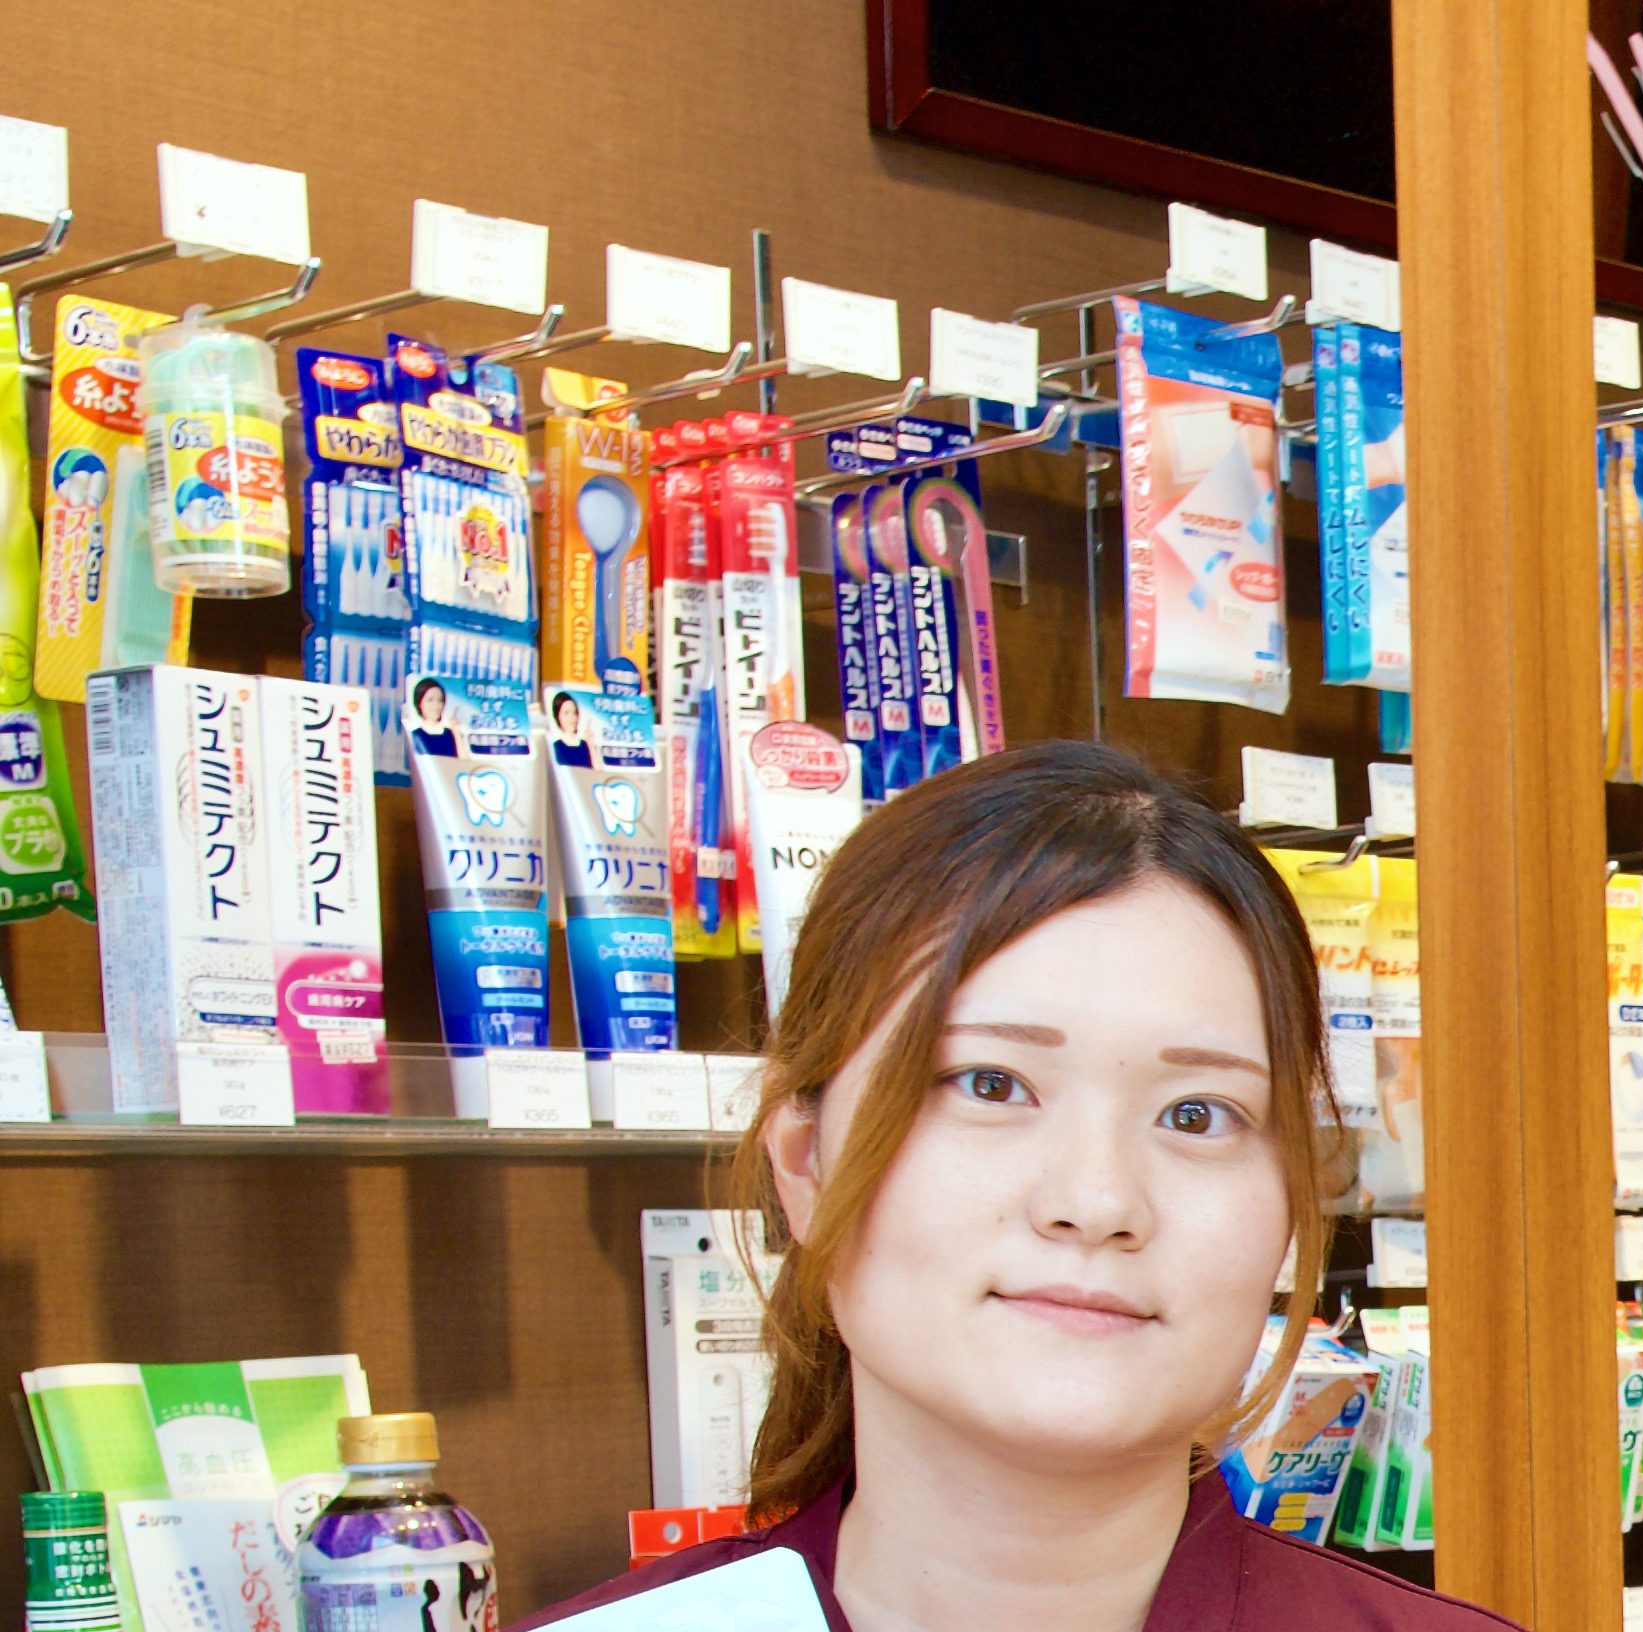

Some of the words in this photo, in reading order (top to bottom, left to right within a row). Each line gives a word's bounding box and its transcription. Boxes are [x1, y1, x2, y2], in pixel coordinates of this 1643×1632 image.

[196, 684, 240, 921] シュミテクト
[301, 695, 345, 927] シュミテクト
[448, 848, 544, 884] クリニカ
[160, 1402, 243, 1421] ここから始める
[178, 1449, 258, 1477] 高血圧
[1266, 1450, 1351, 1476] ケアリーヴ
